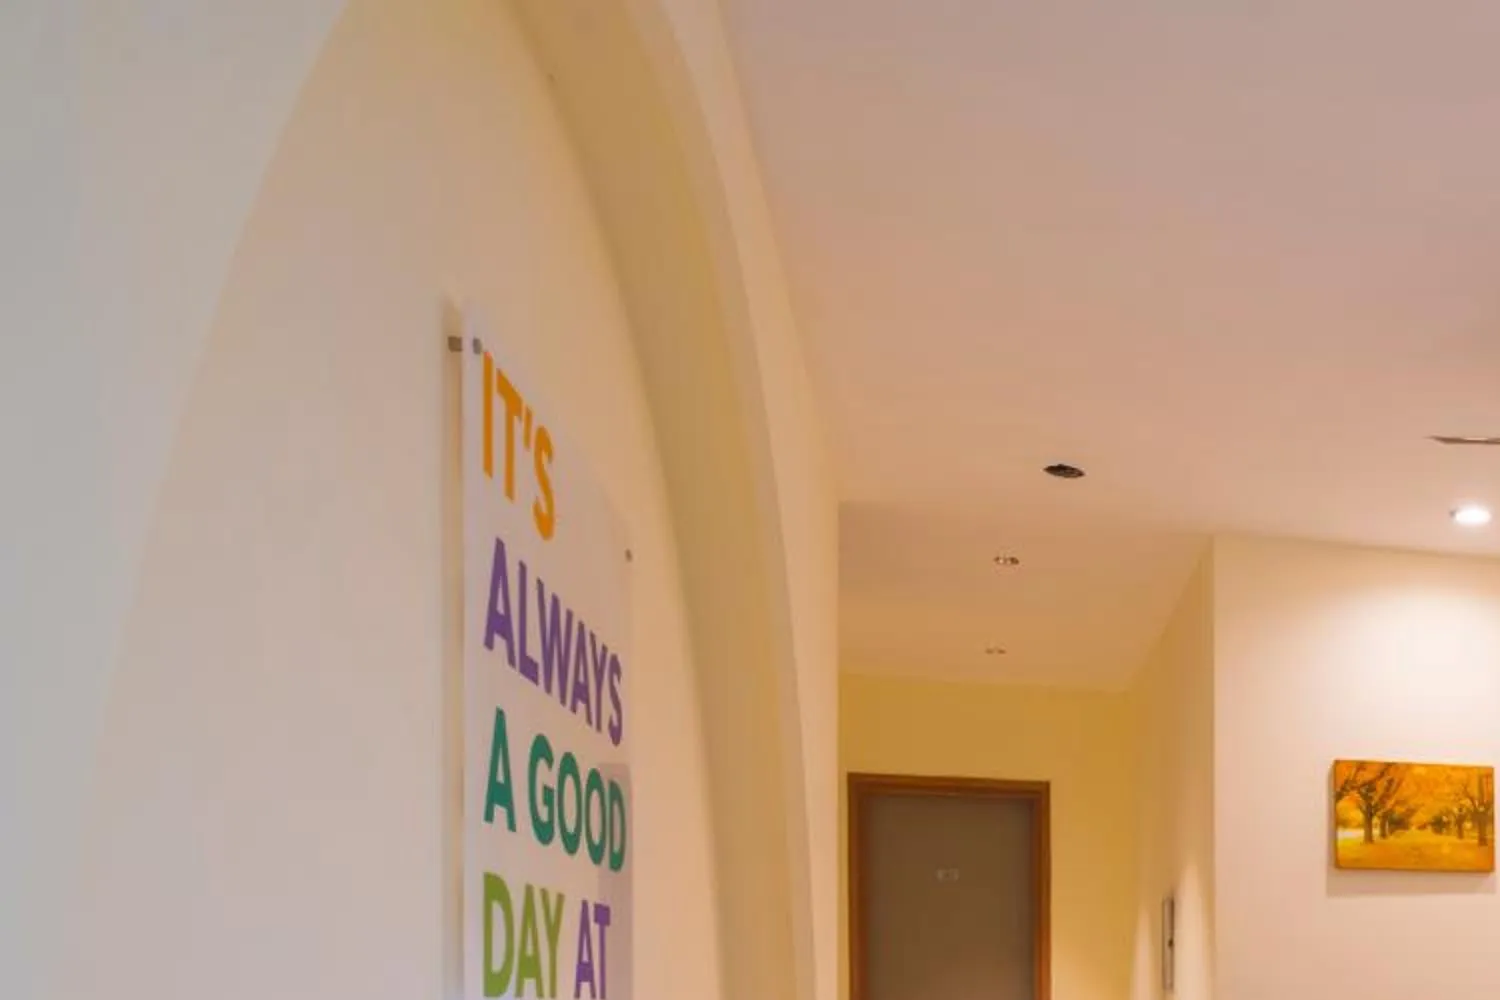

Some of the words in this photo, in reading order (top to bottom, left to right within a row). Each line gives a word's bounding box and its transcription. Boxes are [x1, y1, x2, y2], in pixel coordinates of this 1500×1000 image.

[482, 350, 556, 541] IT'S
[483, 536, 624, 747] ALWAYS
[483, 705, 517, 833] A
[527, 732, 627, 873] GOOD
[482, 871, 566, 999] DAY
[573, 899, 612, 1000] AT
